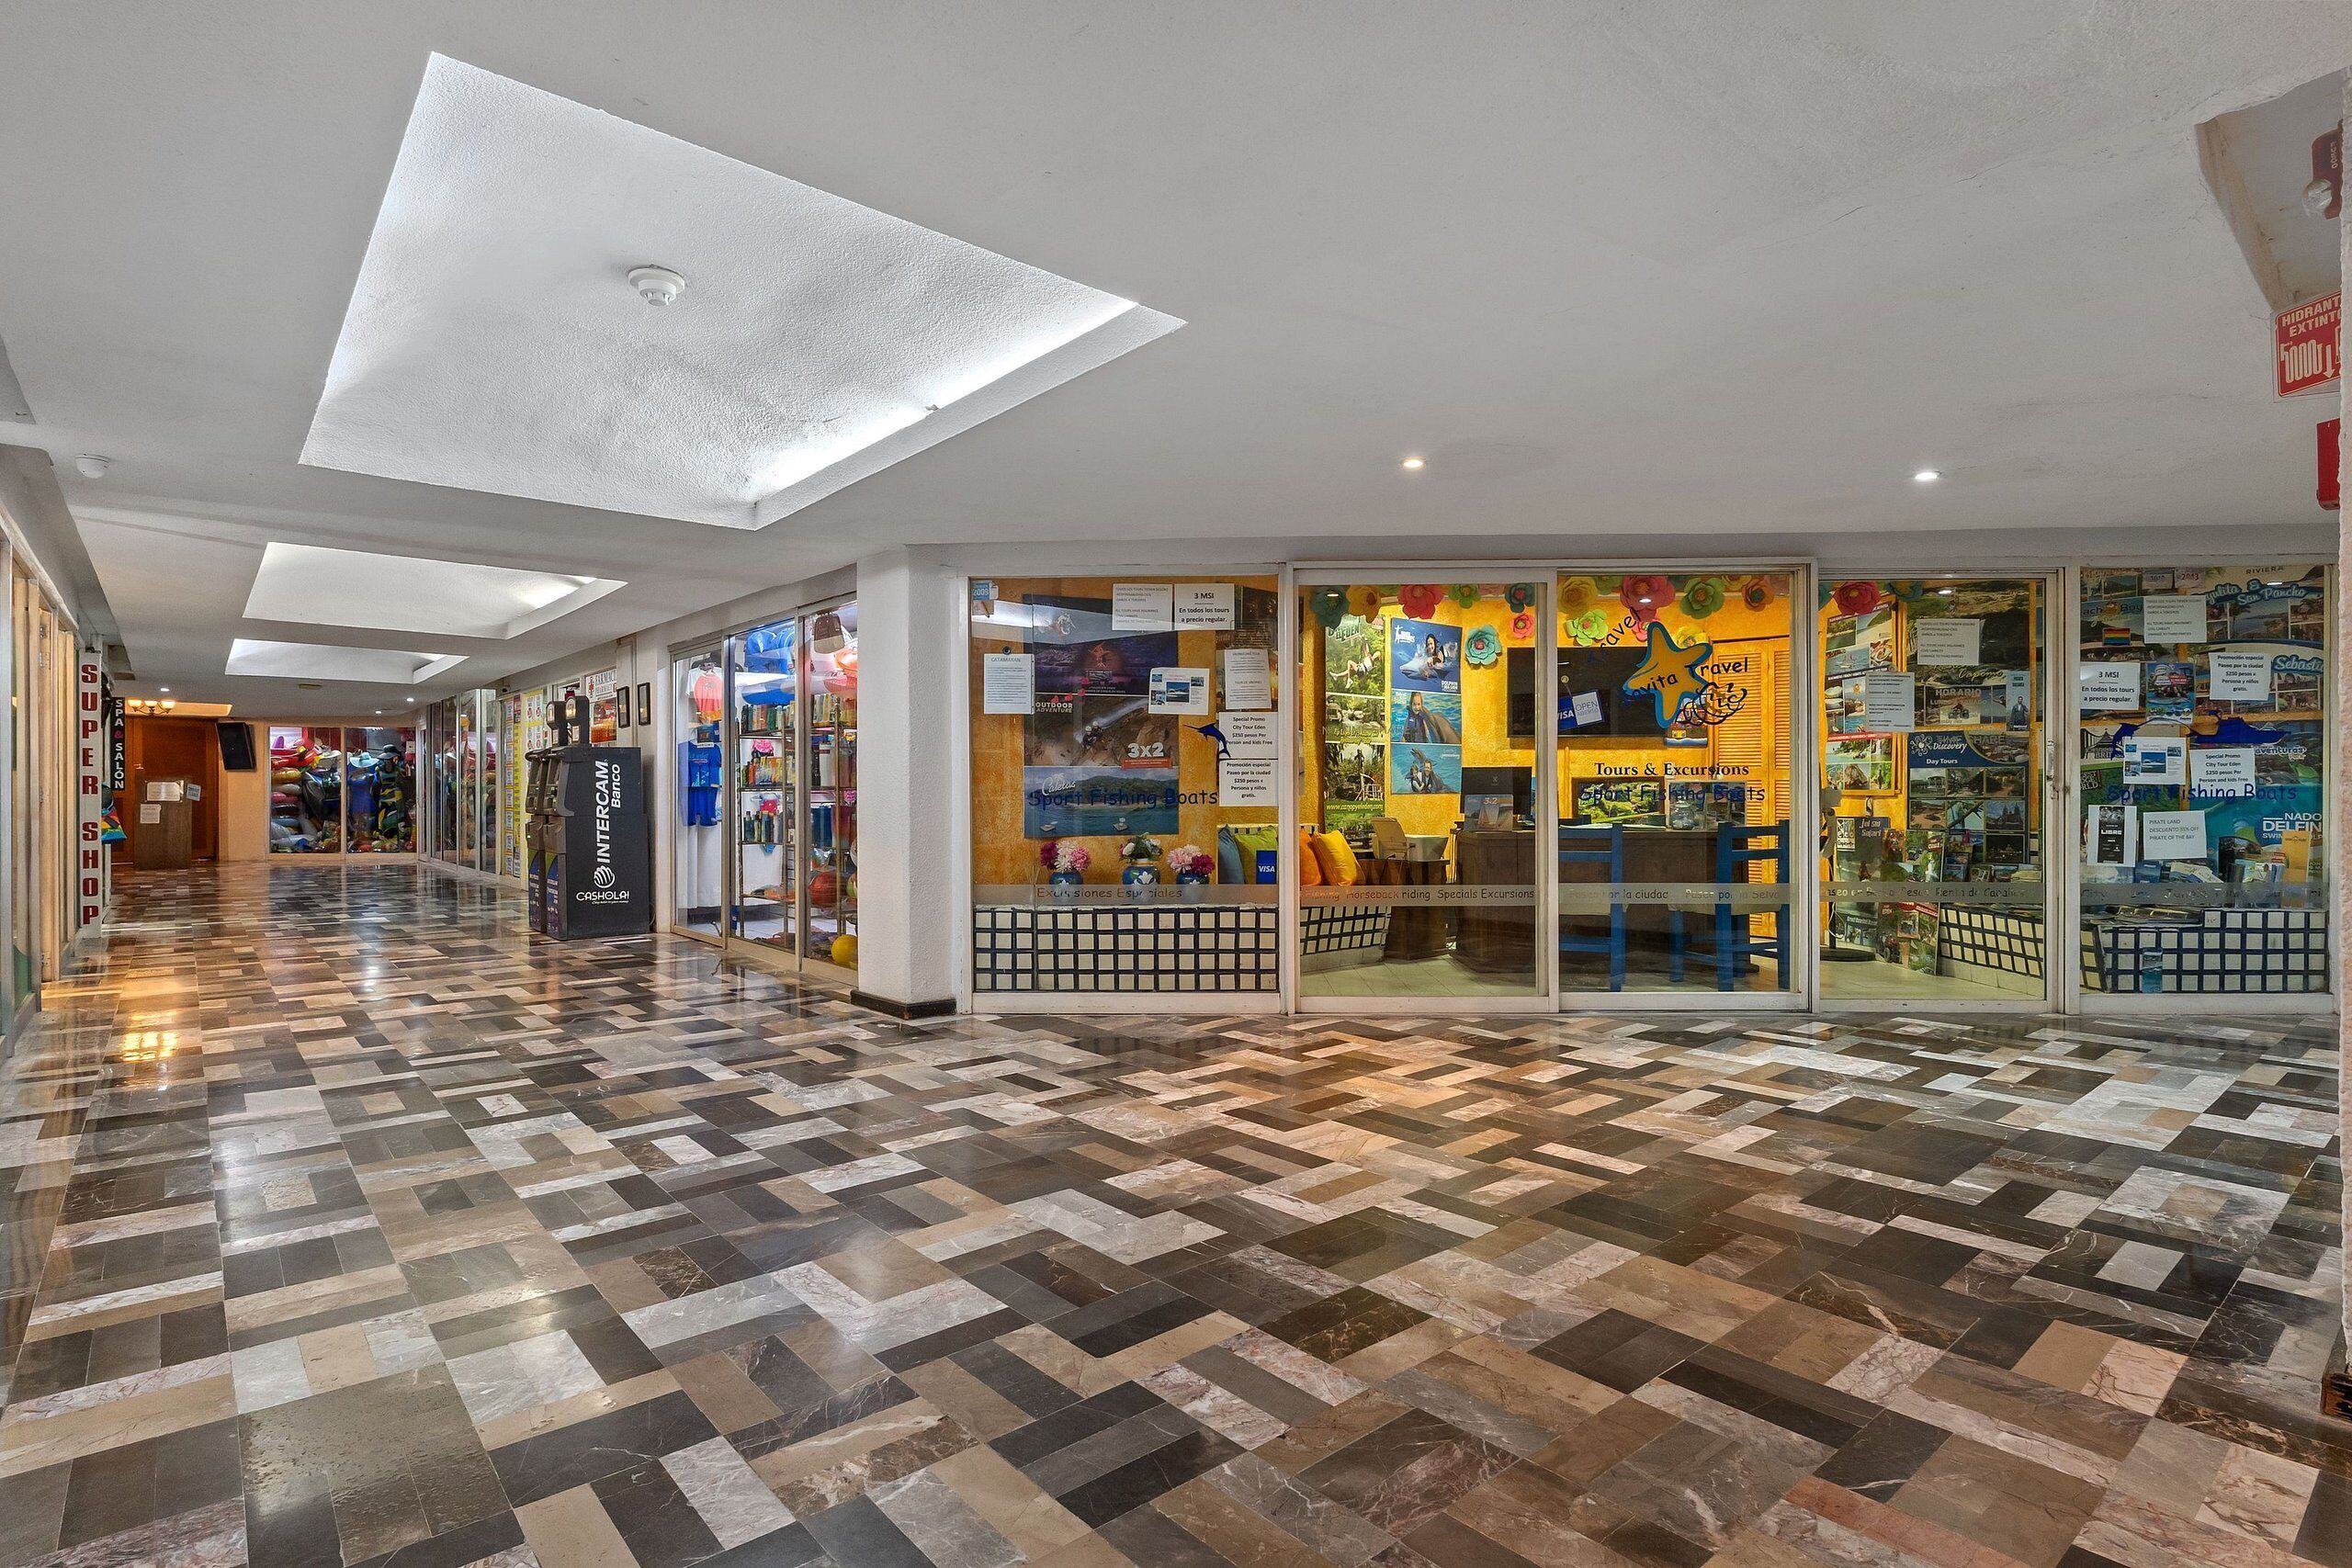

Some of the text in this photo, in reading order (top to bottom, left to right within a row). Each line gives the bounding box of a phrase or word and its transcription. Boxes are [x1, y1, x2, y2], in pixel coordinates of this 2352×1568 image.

[1684, 657, 1748, 679] Travel
[115, 699, 124, 727] SPA
[1556, 710, 1575, 720] ISA
[1576, 701, 1599, 712] OPEN
[81, 664, 98, 795] SUPER
[115, 730, 124, 739] &
[1127, 741, 1164, 758] 3x2
[115, 742, 125, 789] SALÓN
[1594, 762, 1749, 775] Tours & Excursions
[1926, 758, 1939, 766] Day
[611, 763, 622, 809] Banco
[1580, 783, 1766, 807] Sport Fishing Boats
[2106, 784, 2162, 805] Sport
[2244, 784, 2297, 801] Boats
[1027, 788, 1218, 808] Sport Fishing Boats
[595, 761, 611, 863] INTERCAM
[2284, 812, 2323, 821] NADO
[82, 821, 99, 925] SHOP
[1258, 864, 1275, 873] VISA
[1401, 888, 1431, 901] riding
[1437, 888, 1478, 901] Specials
[1481, 887, 1535, 898] Excursions
